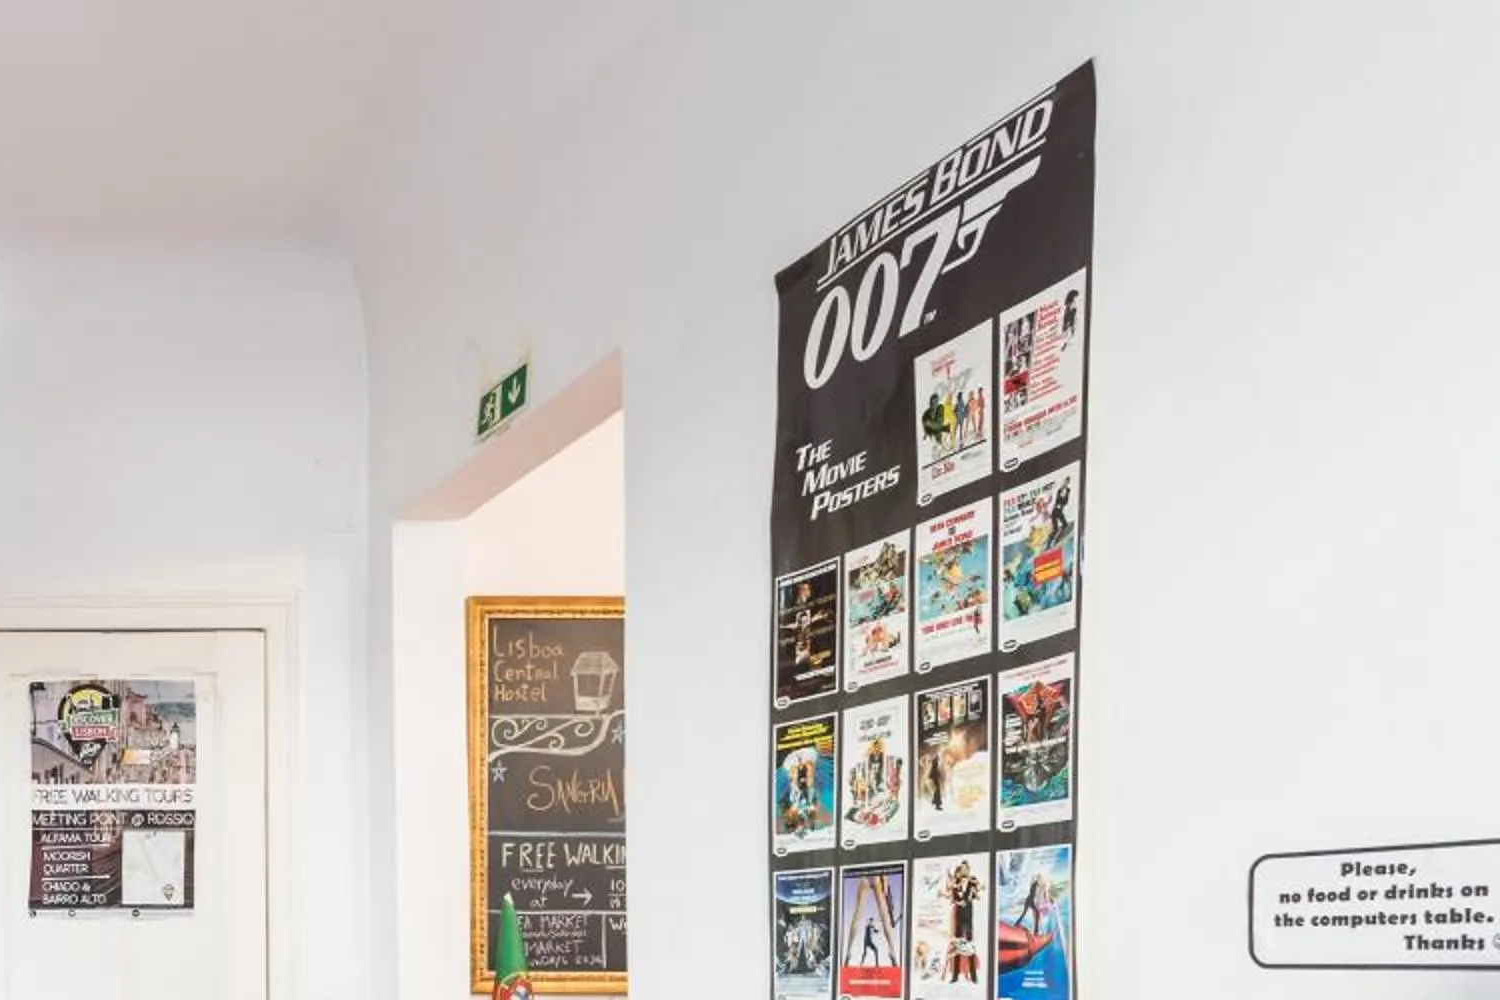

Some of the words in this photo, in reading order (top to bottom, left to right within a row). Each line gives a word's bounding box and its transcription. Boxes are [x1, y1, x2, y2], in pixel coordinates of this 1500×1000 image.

[816, 177, 929, 284] JAMES
[930, 99, 1054, 206] BOND
[804, 204, 964, 389] 007
[795, 439, 833, 472] THE
[801, 451, 867, 497] MOVIE
[810, 464, 901, 521] POSTERS
[493, 626, 565, 658] Lisboa
[493, 659, 558, 683] Central
[493, 682, 548, 703] Hostel
[71, 787, 141, 802] WALKING
[144, 788, 194, 802] TOURS
[33, 813, 87, 826] MEETING
[89, 812, 128, 826] POINT
[501, 841, 556, 869] FREE
[1340, 861, 1417, 878] Please,
[1278, 891, 1302, 904] no
[1306, 887, 1352, 903] food
[1356, 889, 1379, 901] or
[1384, 882, 1453, 900] drinks
[1460, 884, 1490, 898] on
[1273, 912, 1306, 928] the
[1310, 911, 1418, 929] computers
[1423, 907, 1495, 926] table.
[1403, 933, 1486, 951] Thanks
